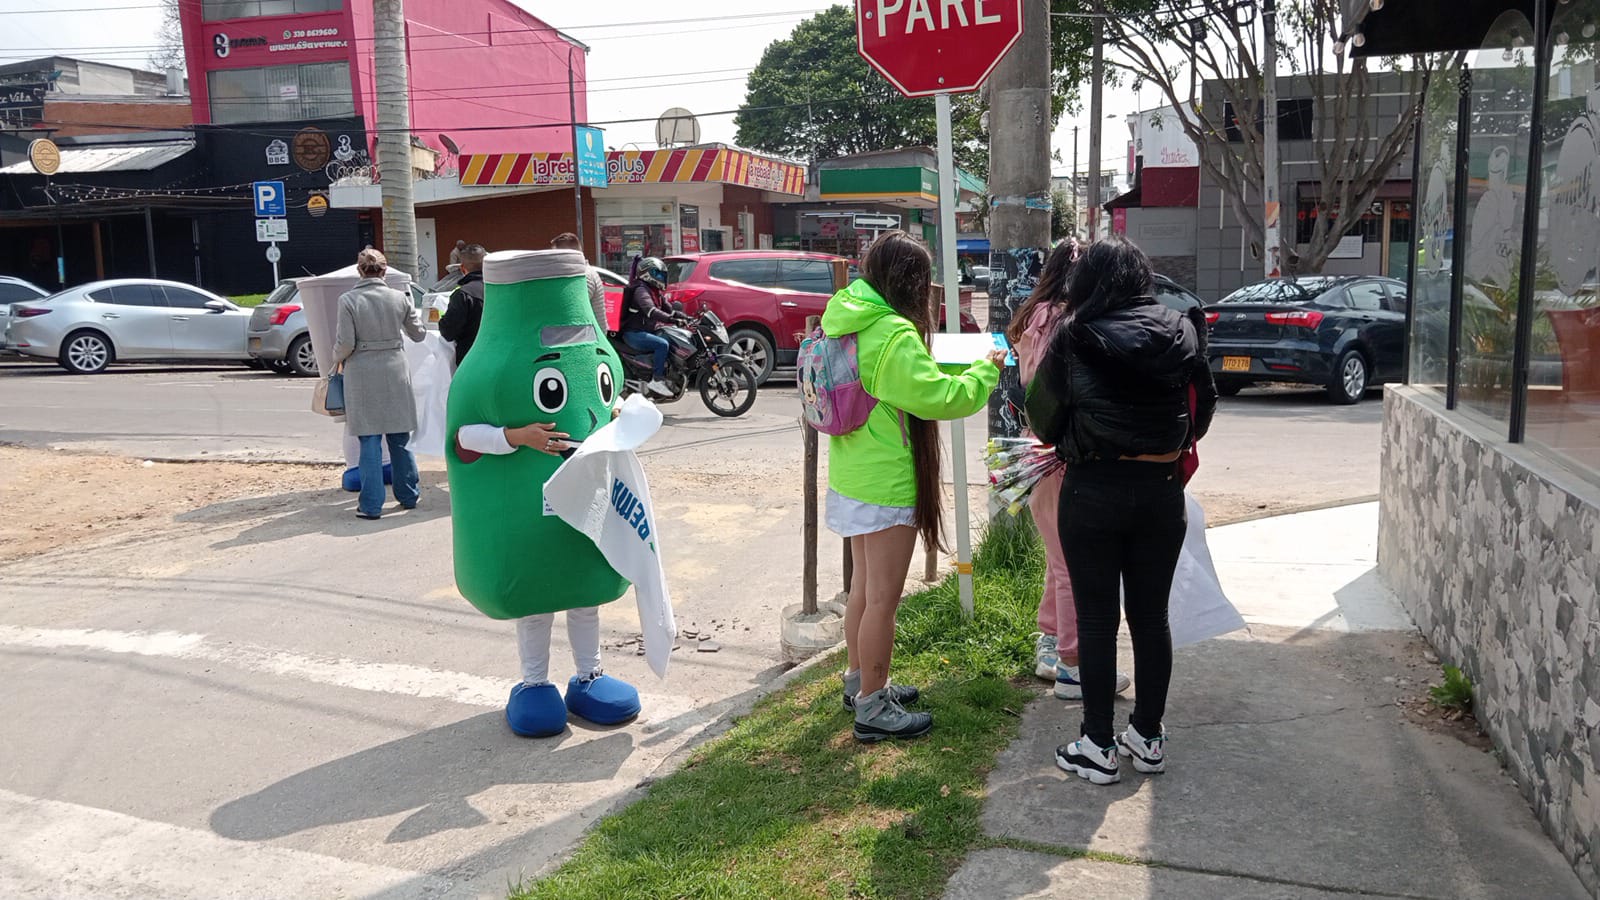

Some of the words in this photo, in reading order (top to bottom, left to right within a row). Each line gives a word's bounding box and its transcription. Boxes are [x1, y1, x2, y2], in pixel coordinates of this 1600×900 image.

[876, 0, 1001, 38] PARE
[268, 155, 286, 163] BBC
[607, 154, 646, 179] plus
[257, 185, 276, 210] P
